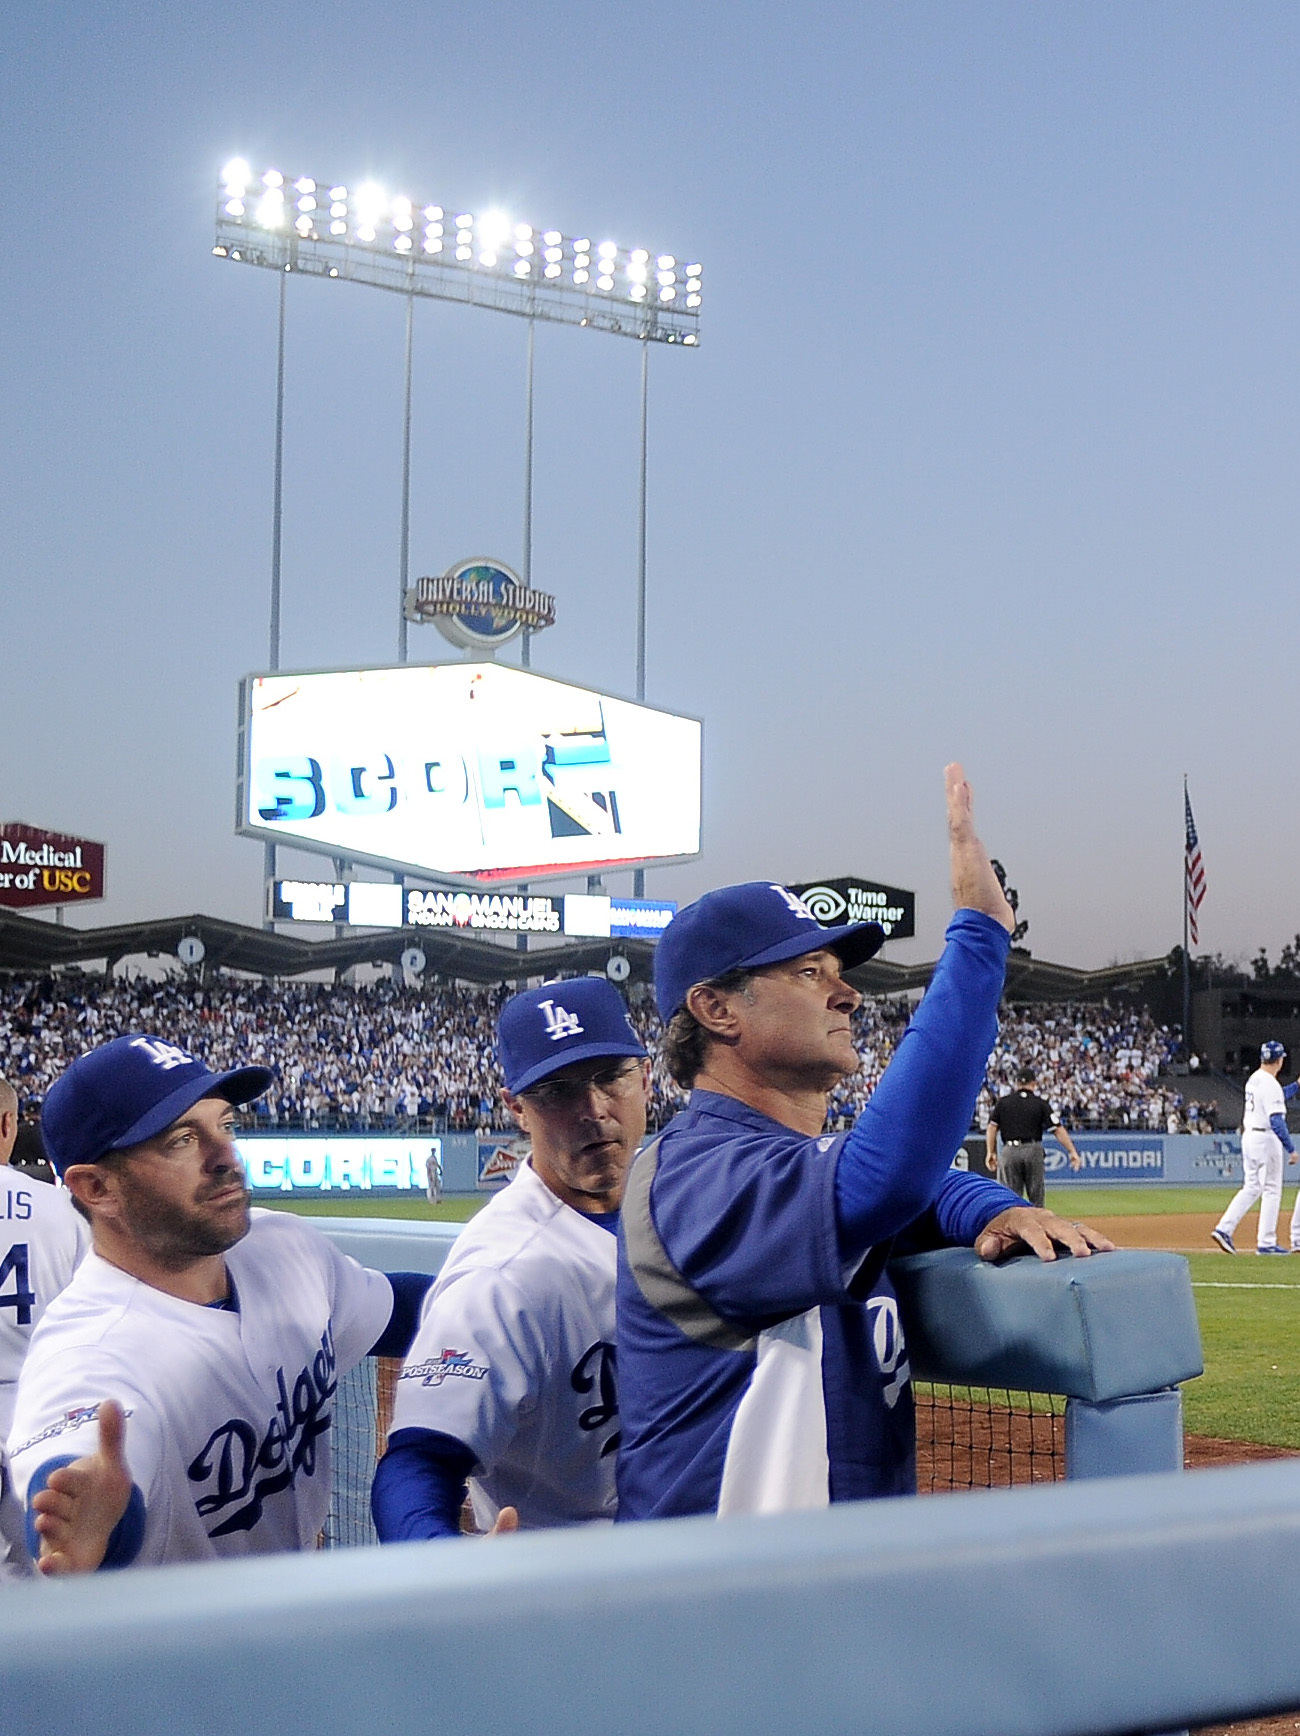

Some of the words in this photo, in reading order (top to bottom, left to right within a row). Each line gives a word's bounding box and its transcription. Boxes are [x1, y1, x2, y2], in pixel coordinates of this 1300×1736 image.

[418, 577, 497, 603] UNIVERSAL
[500, 581, 556, 616] STUDIOS
[436, 602, 539, 625] HOLLYWOOD
[1, 840, 83, 868] Medical
[15, 867, 40, 890] of
[42, 869, 91, 893] USC
[470, 893, 559, 922] MANUEL
[847, 887, 887, 906] Time
[847, 902, 905, 921] Warner
[538, 999, 584, 1040] LA
[129, 1037, 193, 1070] LA
[400, 1363, 488, 1380] POSTSEASON
